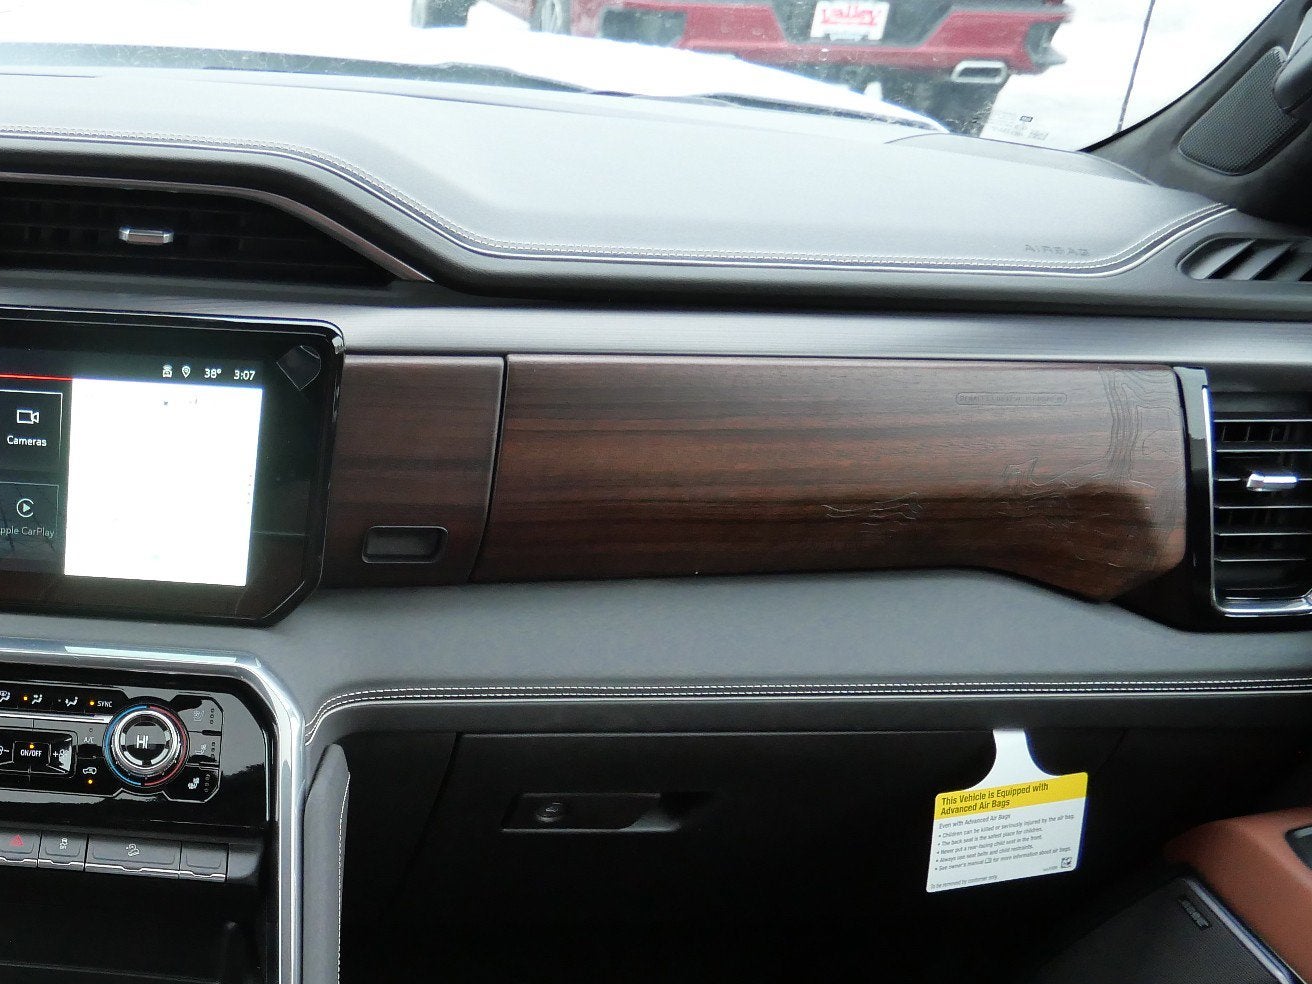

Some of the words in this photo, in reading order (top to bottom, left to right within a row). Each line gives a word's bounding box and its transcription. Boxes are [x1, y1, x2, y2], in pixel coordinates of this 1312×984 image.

[204, 368, 222, 379] 38°
[233, 369, 256, 380] 3:07
[6, 435, 47, 447] Cameras
[21, 526, 55, 539] CarPlay
[97, 700, 113, 708] SYNC
[136, 735, 148, 750] HI
[20, 749, 43, 758] ON/OFF
[942, 796, 957, 806] This
[959, 792, 987, 803] Vehicle
[988, 790, 995, 799] is
[996, 785, 1031, 799] Equipped
[1032, 782, 1049, 792] with
[940, 803, 977, 816] Advanced
[979, 801, 990, 810] Air
[991, 799, 1010, 809] Bags
